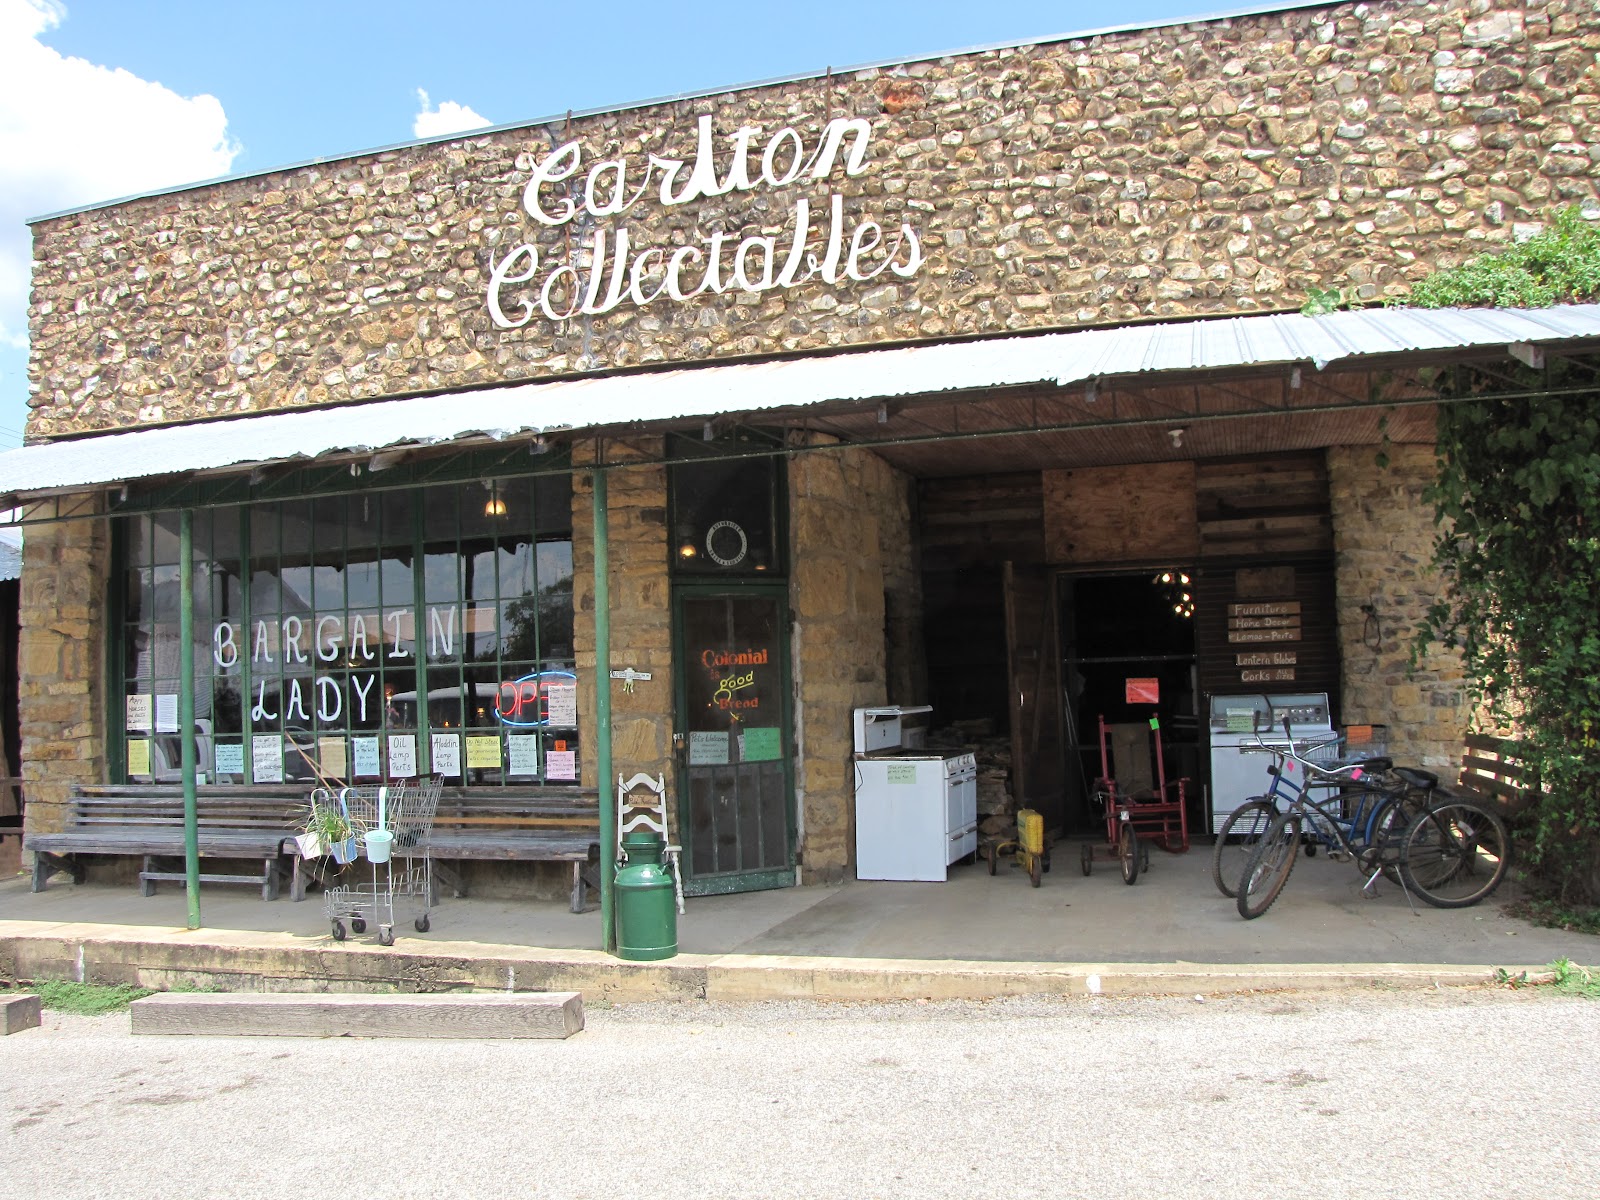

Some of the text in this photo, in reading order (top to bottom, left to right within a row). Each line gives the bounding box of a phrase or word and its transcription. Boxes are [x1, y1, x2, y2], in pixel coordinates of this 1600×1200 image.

[523, 114, 872, 226] Carlton
[486, 194, 927, 328] Collectables
[1235, 603, 1288, 615] Furniture
[1236, 617, 1290, 629] Home Decor
[213, 605, 456, 667] BARGAIN
[702, 648, 768, 668] Colonial
[1237, 652, 1297, 666] Lantern Globes
[1241, 670, 1270, 682] Corks
[713, 670, 754, 704] good
[252, 673, 375, 722] LADY
[719, 697, 759, 710] Bread
[393, 736, 407, 749] Oil
[691, 732, 704, 743] Pets
